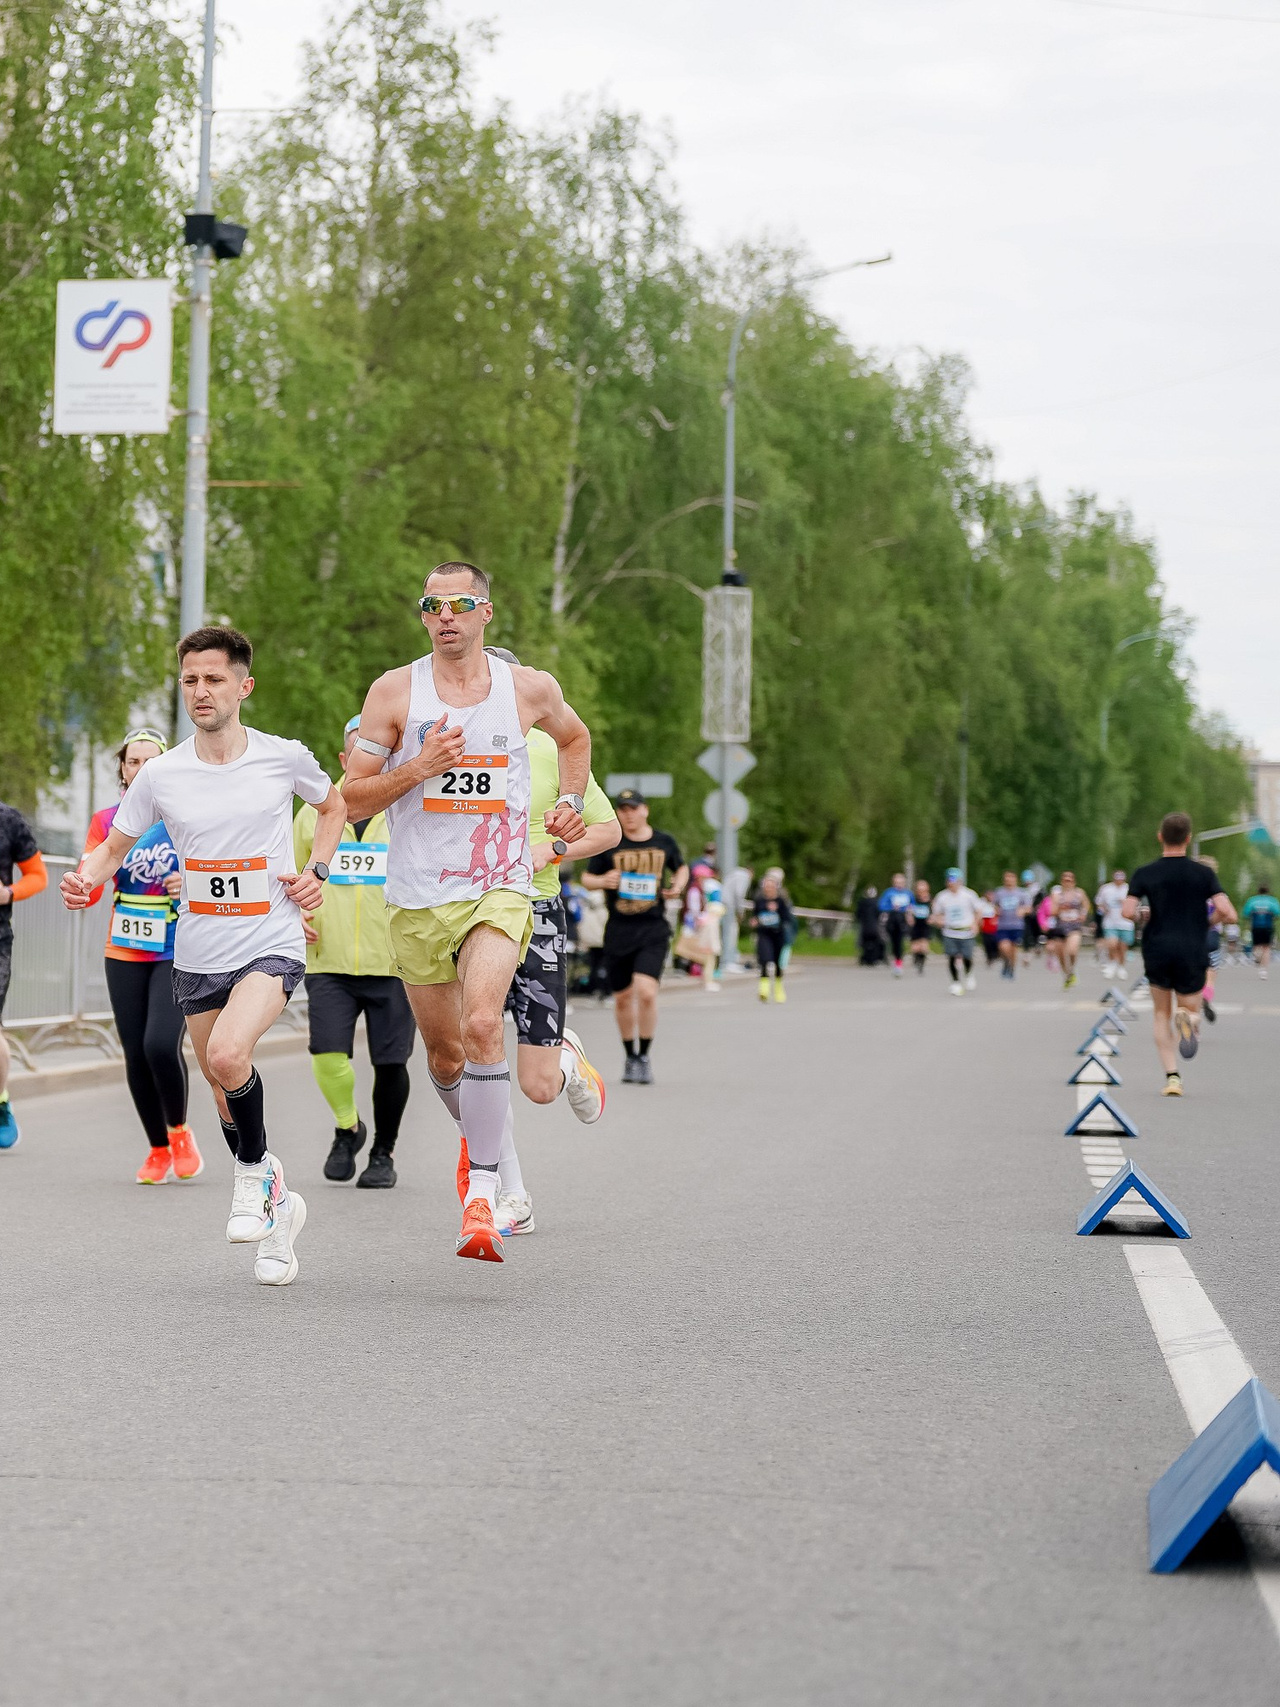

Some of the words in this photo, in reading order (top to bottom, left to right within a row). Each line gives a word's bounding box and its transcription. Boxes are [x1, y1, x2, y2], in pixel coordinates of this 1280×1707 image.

[441, 772, 491, 794] 238
[123, 842, 177, 868] LONG
[340, 856, 374, 871] 599
[128, 856, 174, 884] RUN
[210, 876, 240, 898] 81
[122, 919, 152, 936] 815
